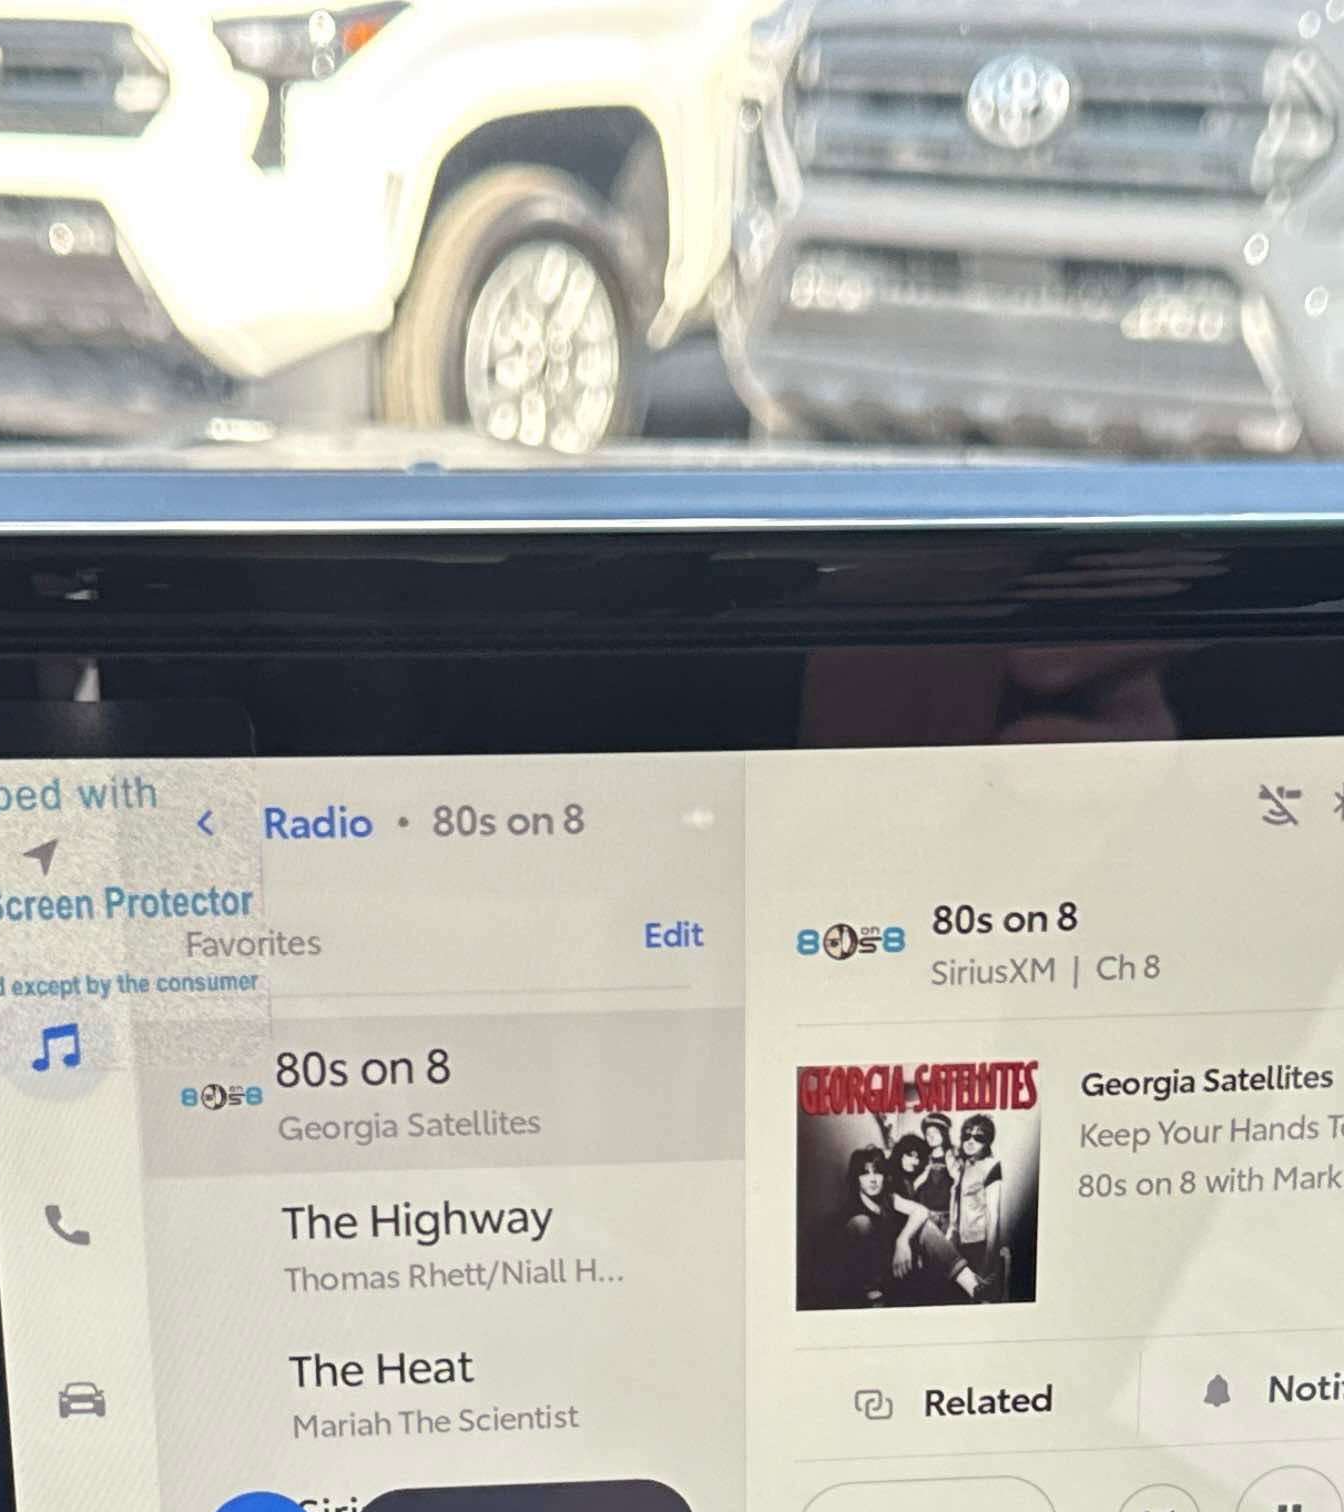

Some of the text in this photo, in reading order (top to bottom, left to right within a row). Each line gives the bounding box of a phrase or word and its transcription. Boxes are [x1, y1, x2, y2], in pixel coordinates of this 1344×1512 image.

[78, 777, 156, 810] with
[264, 803, 585, 839] Radio 80s on 8
[104, 885, 253, 918] Protector
[644, 922, 704, 948] Edit
[933, 902, 1078, 937] 80s on 8
[186, 930, 321, 958] Favorites
[11, 977, 80, 998] except
[86, 975, 111, 998] by
[117, 970, 150, 993] the
[156, 974, 258, 993] consumer
[931, 957, 1056, 987] SiriusXM
[1097, 955, 1136, 982] Ch
[1144, 954, 1161, 979] 8
[276, 1048, 451, 1087] 80s on 8
[1082, 1065, 1333, 1101] Georgia Satellites
[799, 1060, 1039, 1116] GEORGIA SATELLITES
[278, 1109, 540, 1145] Georgia Satellites
[1080, 1121, 1150, 1153] Keep
[1158, 1120, 1222, 1146] Your
[1230, 1116, 1320, 1143] Hands
[1079, 1173, 1128, 1199] 80s
[1137, 1175, 1173, 1196] on
[1179, 1170, 1197, 1195] 8
[1205, 1165, 1264, 1193] with
[1273, 1163, 1344, 1190] Mark
[283, 1201, 552, 1245] The Highway
[284, 1264, 400, 1293] Thomas
[409, 1259, 566, 1290] Rhett/Niall
[289, 1350, 474, 1388] The Heat
[925, 1385, 1052, 1417] Related
[293, 1405, 579, 1439] Mariah The Scientist
